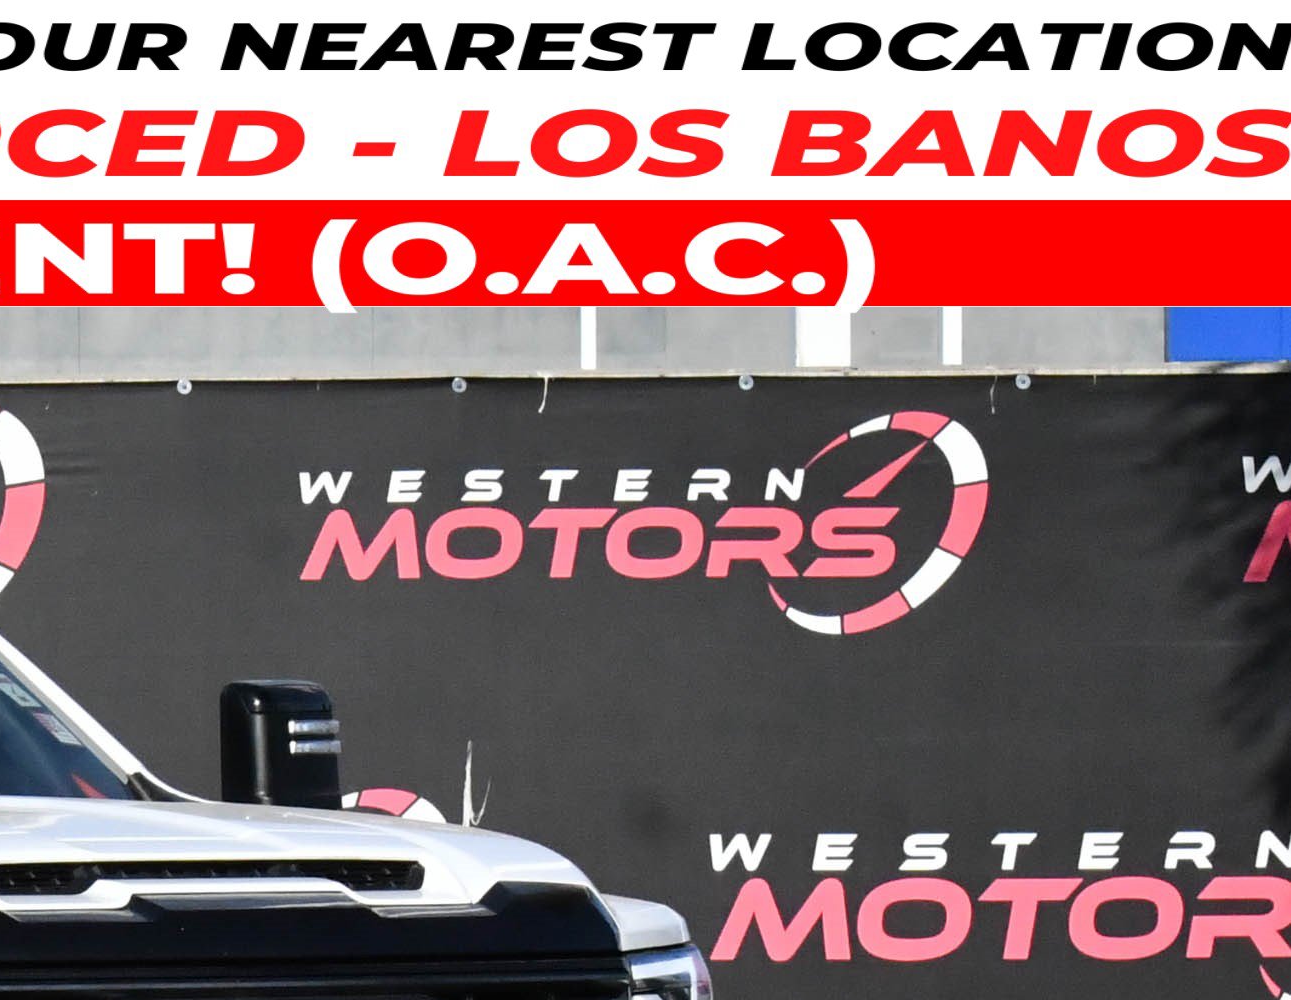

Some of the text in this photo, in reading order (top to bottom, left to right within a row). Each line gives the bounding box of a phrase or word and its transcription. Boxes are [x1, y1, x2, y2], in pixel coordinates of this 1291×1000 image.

[299, 468, 805, 505] WESTERN
[300, 505, 900, 583] MOTORS
[709, 830, 1291, 872] WESTERN
